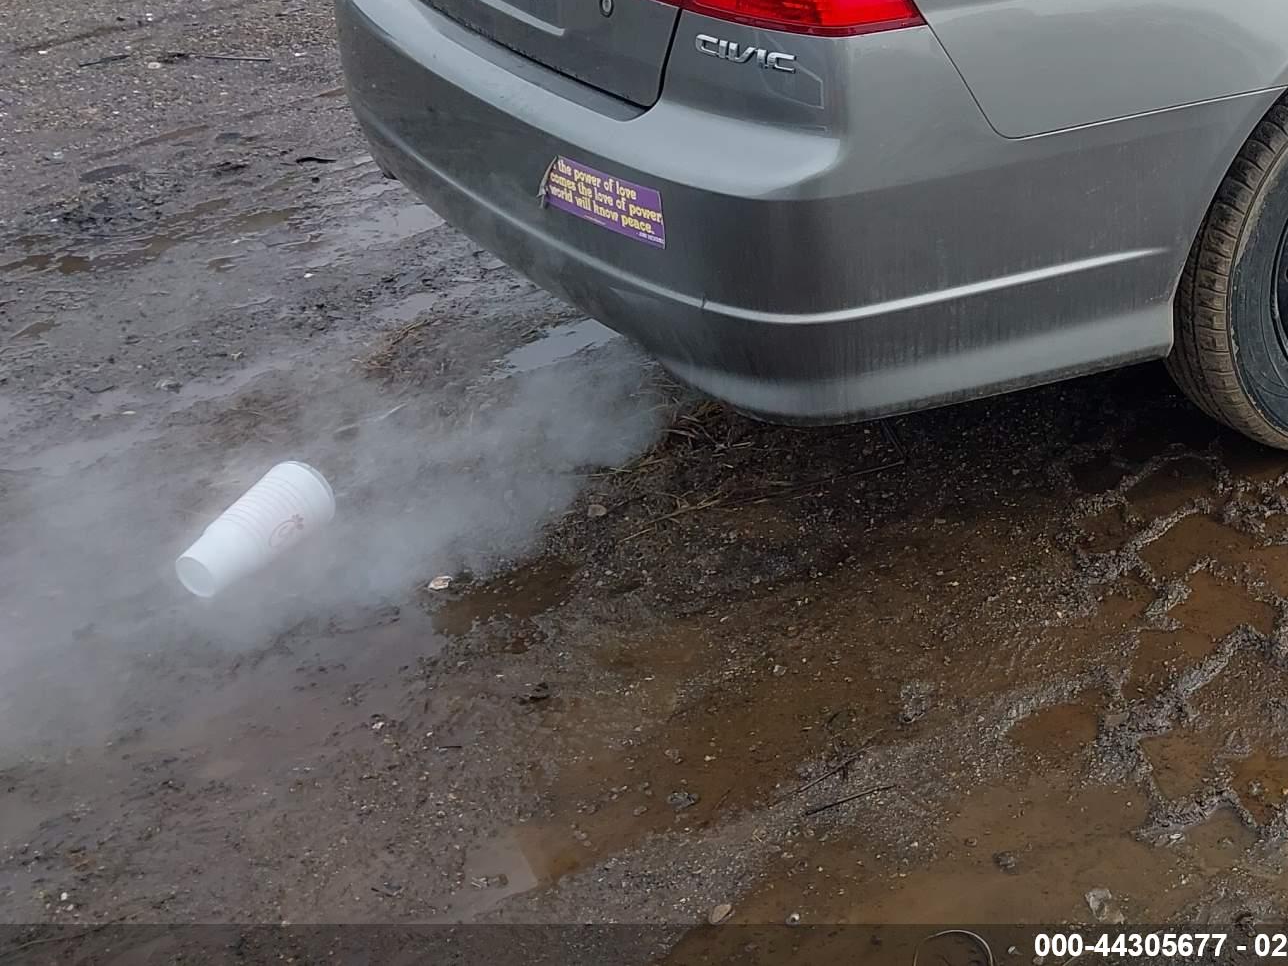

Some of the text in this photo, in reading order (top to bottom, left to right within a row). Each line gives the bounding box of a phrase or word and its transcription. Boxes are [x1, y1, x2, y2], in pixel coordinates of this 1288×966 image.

[695, 33, 797, 73] CIVIC
[557, 159, 637, 200] the power of love
[578, 181, 593, 198] the
[593, 187, 614, 206] love
[615, 197, 626, 212] of
[549, 185, 573, 203] world
[574, 196, 593, 211] will
[592, 199, 619, 222] know
[620, 215, 655, 234] peace.
